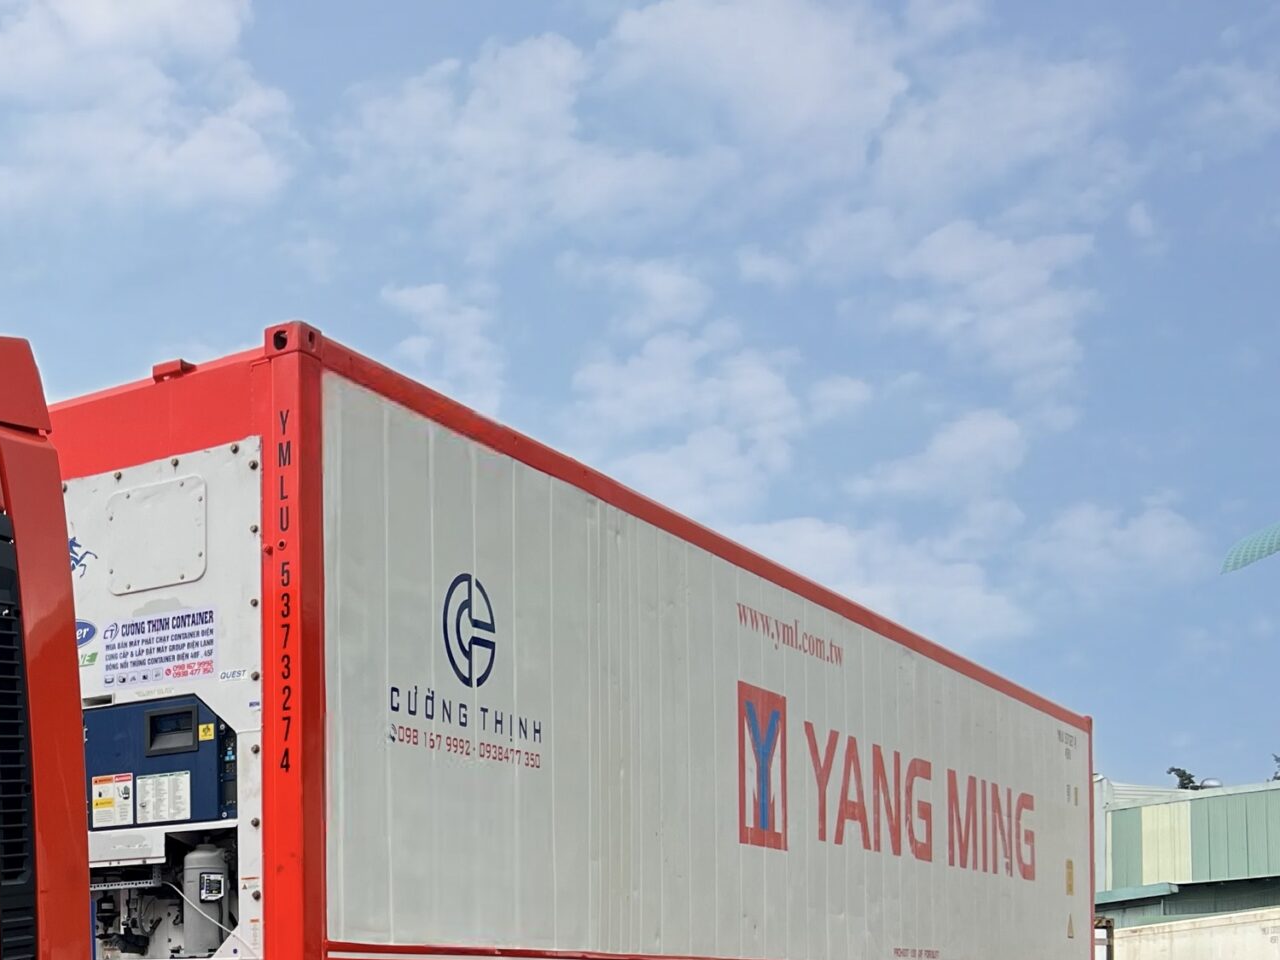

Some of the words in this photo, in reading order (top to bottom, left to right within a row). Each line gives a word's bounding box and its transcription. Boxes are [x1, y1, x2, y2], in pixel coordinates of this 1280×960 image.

[277, 410, 292, 532] YMLU
[171, 610, 214, 630] CONTAINER
[736, 602, 844, 668] www.yml.com.tw
[220, 670, 246, 680] QUEST
[279, 561, 292, 774] 5373274
[390, 685, 468, 728] CƯỜNG
[479, 706, 542, 744] THỊNH
[423, 731, 442, 751] 167
[445, 736, 471, 756] 9992
[804, 720, 933, 863] YANG
[947, 768, 1036, 882] MING
